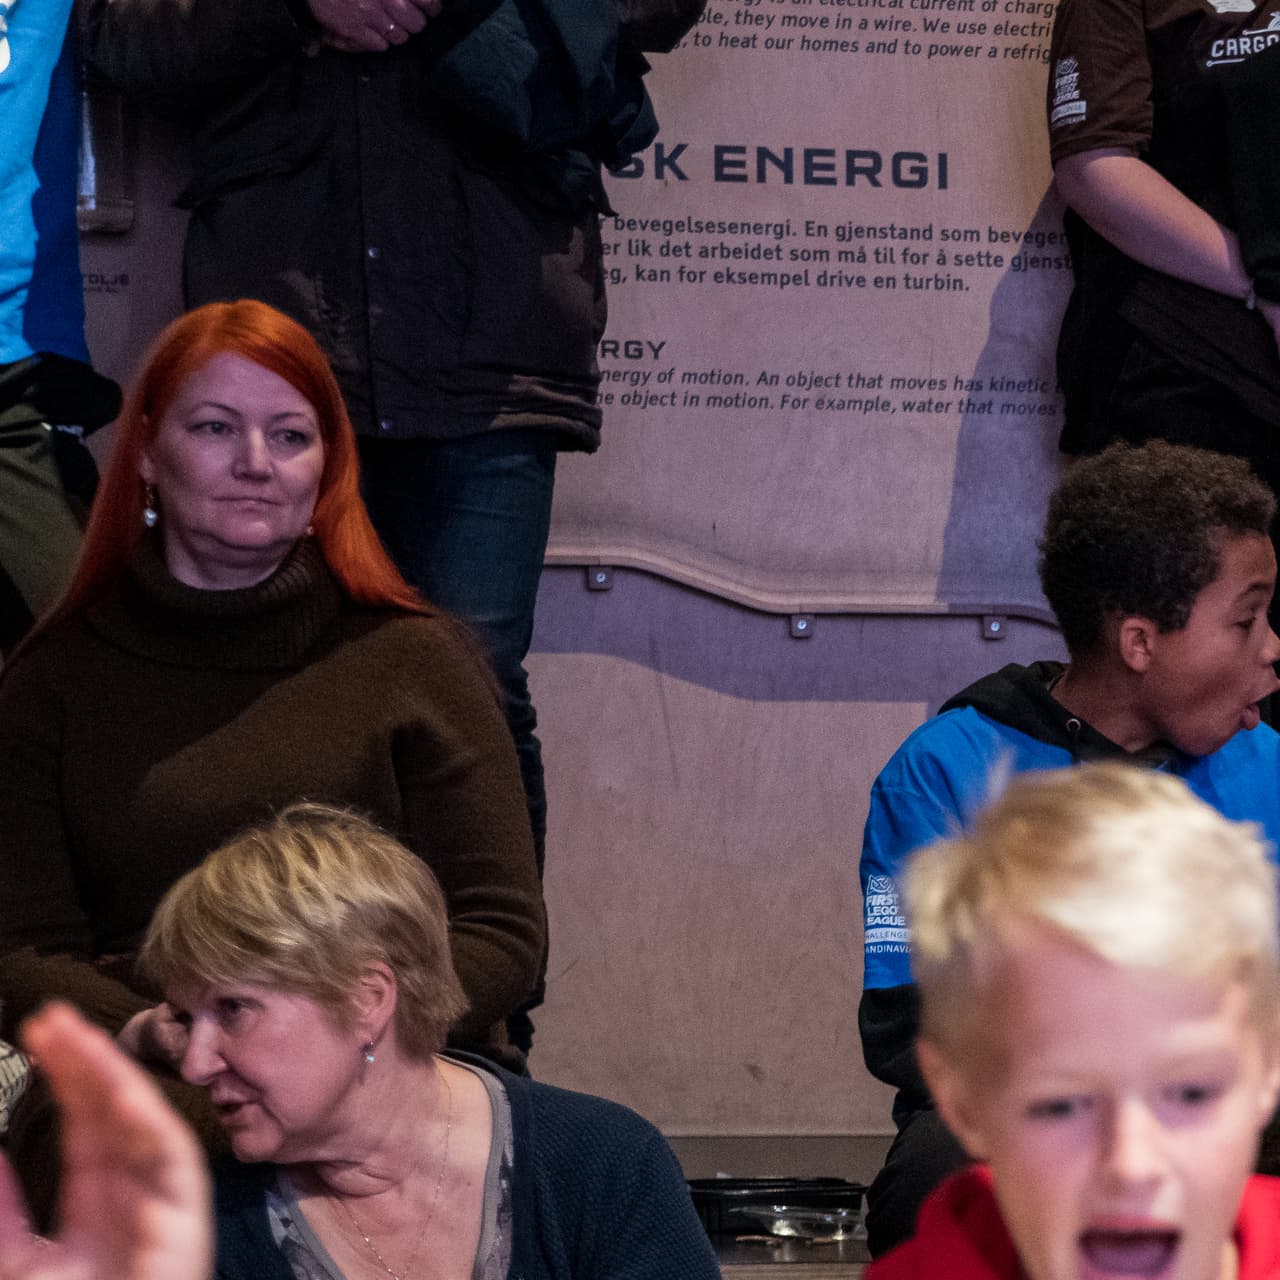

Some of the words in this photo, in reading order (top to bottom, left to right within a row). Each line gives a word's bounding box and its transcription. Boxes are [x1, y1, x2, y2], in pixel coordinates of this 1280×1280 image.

[910, 0, 976, 12] current
[981, 0, 997, 13] of
[734, 9, 776, 31] they
[781, 14, 830, 29] move
[835, 14, 853, 30] in
[858, 19, 868, 31] a
[874, 15, 918, 33] wire.
[923, 18, 951, 34] We
[956, 24, 987, 36] use
[694, 31, 712, 48] to
[718, 32, 758, 50] heat
[764, 37, 795, 51] our
[800, 35, 860, 53] homes
[866, 38, 898, 55] and
[903, 41, 922, 56] to
[927, 44, 982, 60] power
[987, 47, 998, 59] a
[714, 144, 949, 190] ENERGI
[613, 216, 798, 240] bevegelsesenergi.
[804, 220, 828, 237] En
[835, 220, 933, 243] gjenstand
[940, 230, 981, 243] som
[627, 238, 653, 257] lik
[659, 241, 693, 258] det
[698, 242, 784, 262] arbeidet
[789, 249, 830, 263] som
[837, 246, 867, 264] må
[873, 247, 897, 265] til
[900, 247, 931, 266] for
[936, 248, 947, 266] å
[953, 254, 1005, 269] sette
[635, 264, 672, 283] kan
[677, 266, 707, 284] for
[713, 267, 811, 290] eksempel
[816, 270, 866, 289] drive
[873, 274, 897, 290] en
[903, 272, 970, 292] turbin.
[657, 367, 676, 384] of
[681, 369, 750, 386] motion.
[756, 371, 780, 386] An
[785, 371, 841, 391] object
[847, 372, 884, 390] that
[890, 378, 948, 392] moves
[953, 376, 984, 392] has
[988, 376, 1049, 394] kinetic
[620, 390, 678, 410] object
[683, 393, 700, 407] in
[706, 393, 774, 411] motion.
[780, 394, 813, 411] For
[815, 396, 897, 415] example,
[902, 399, 953, 415] water
[958, 396, 994, 415] that
[1000, 399, 1057, 416] moves
[867, 905, 899, 917] LEGO
